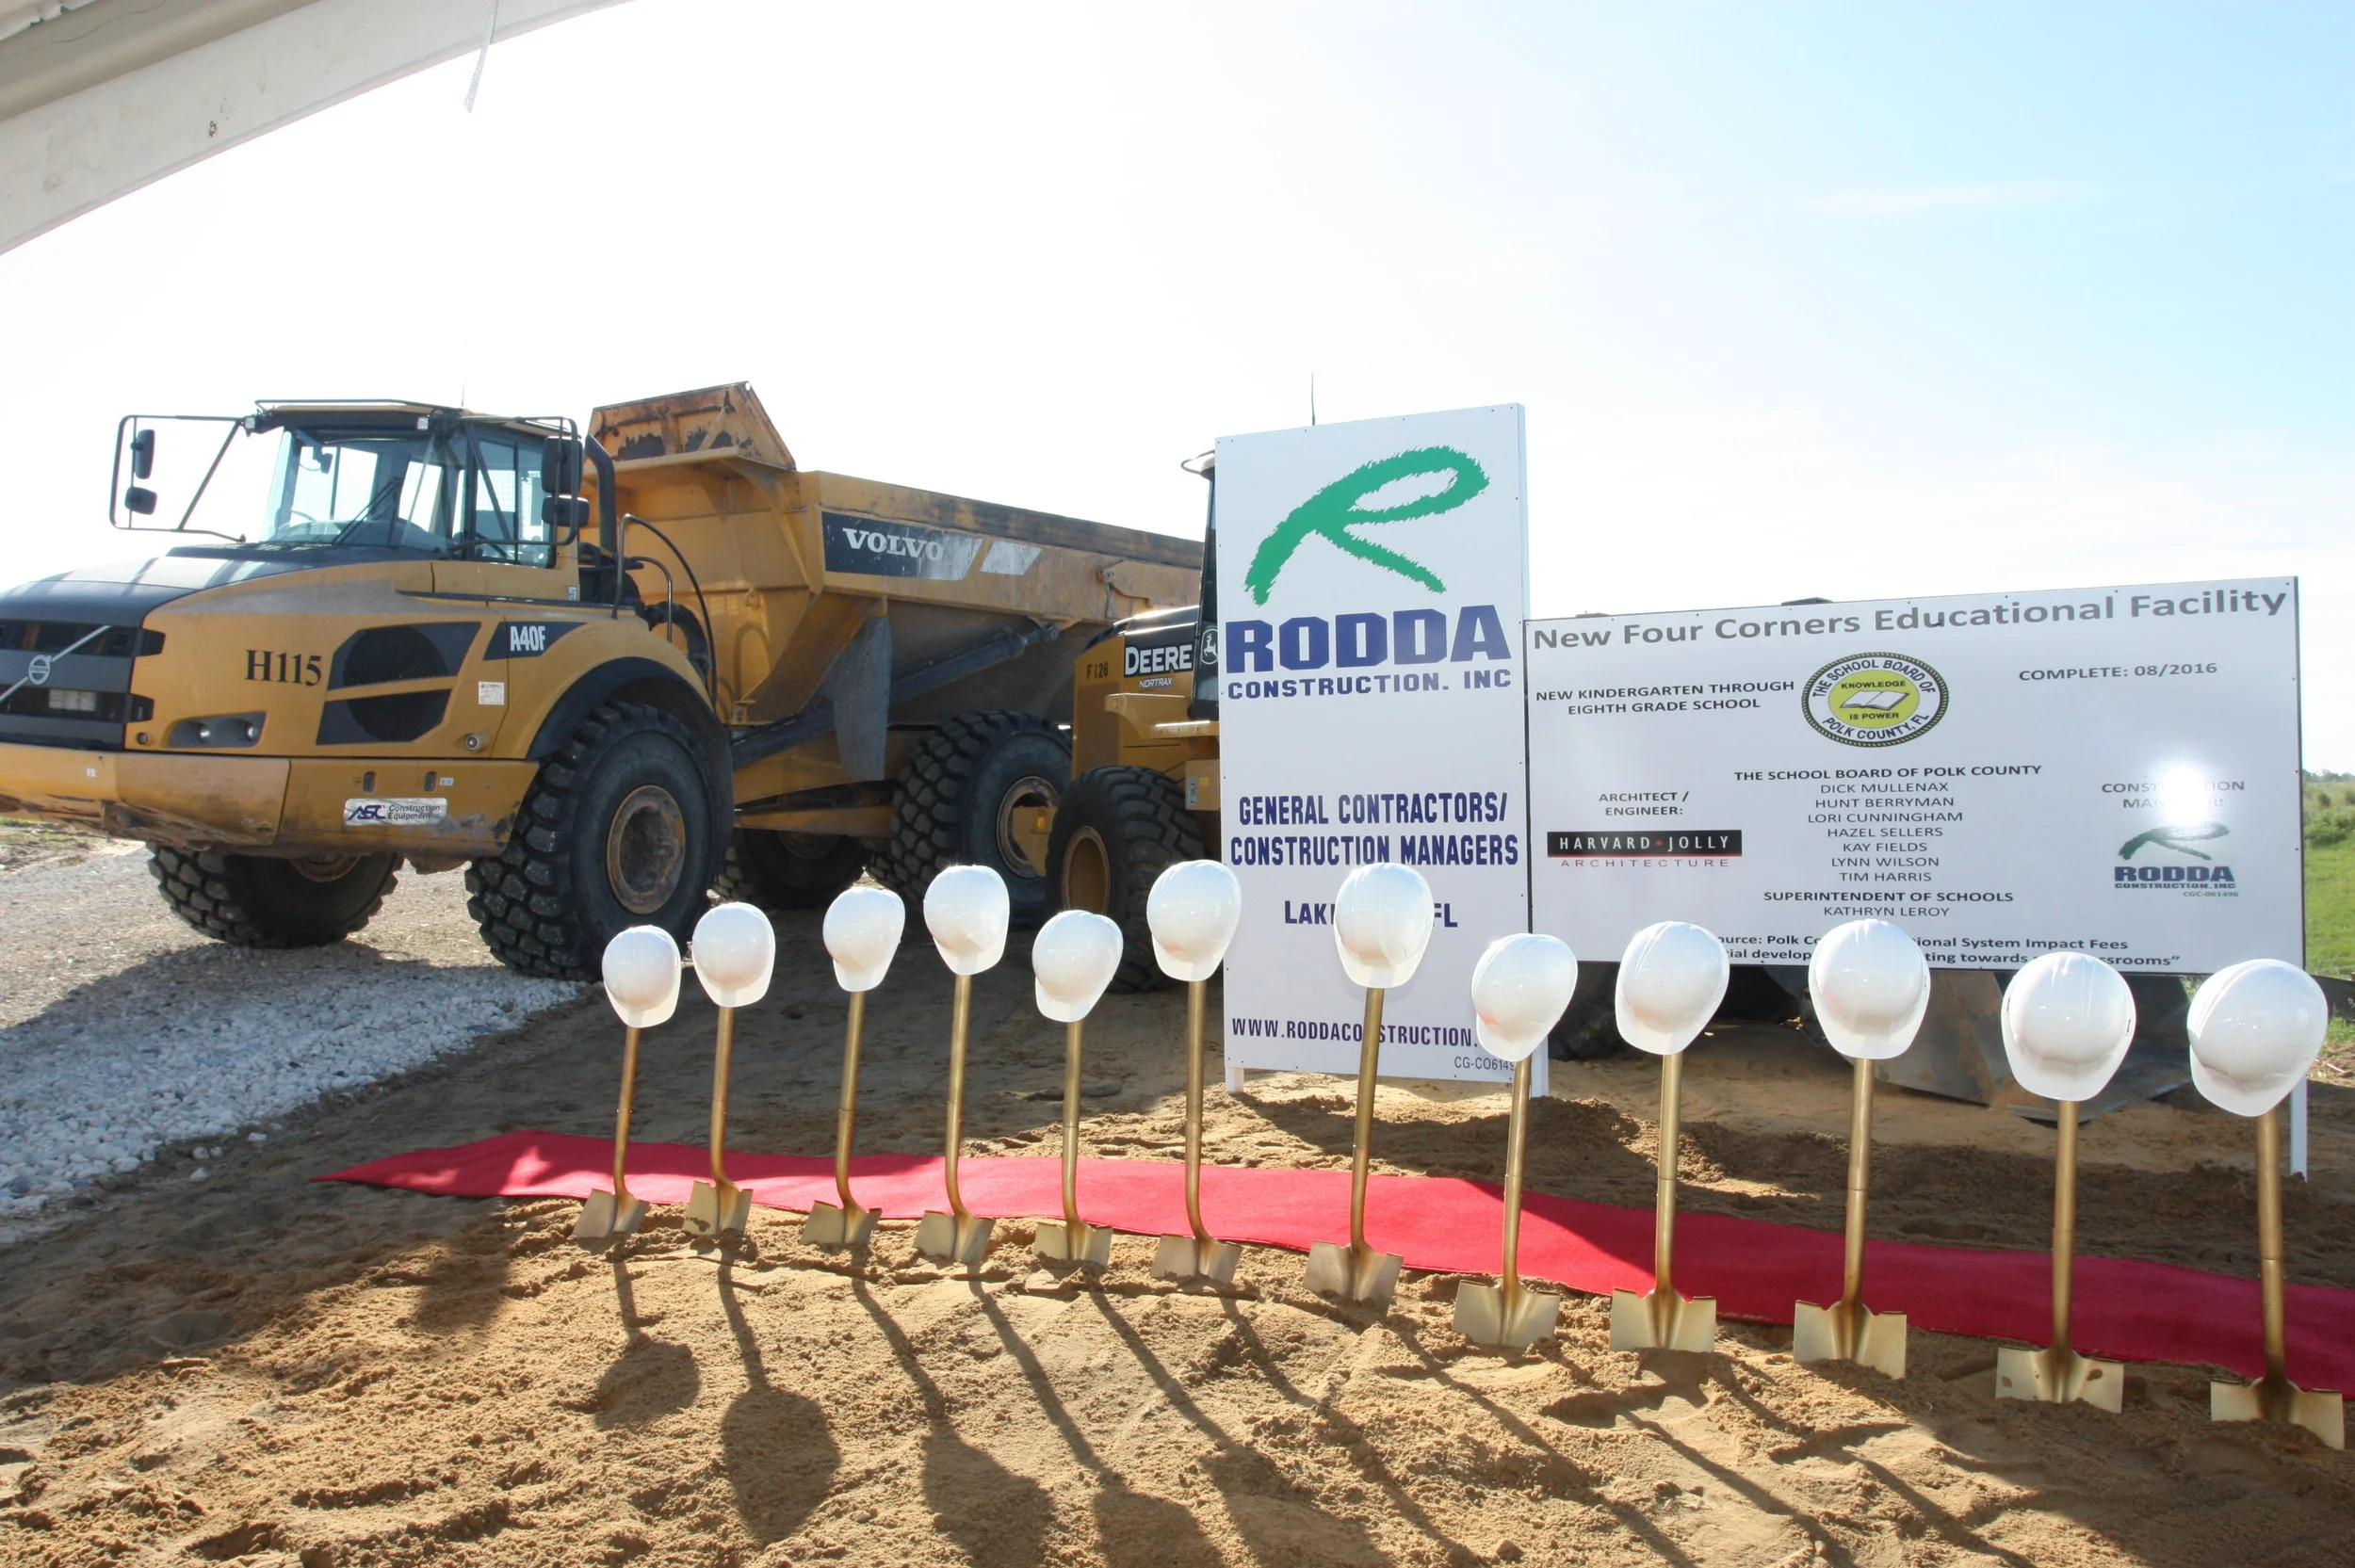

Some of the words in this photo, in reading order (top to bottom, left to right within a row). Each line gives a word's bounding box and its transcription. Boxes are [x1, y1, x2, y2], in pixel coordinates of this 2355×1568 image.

[842, 526, 943, 561] VOLVO
[1535, 629, 1611, 649] New
[1624, 623, 1703, 644] Four
[1715, 613, 1860, 639] Corners
[1876, 595, 2114, 631] Educational
[2131, 590, 2286, 618] Facility
[510, 625, 545, 652] A40F
[1226, 605, 1512, 673] RODDA
[245, 649, 322, 687] H115
[1125, 644, 1193, 676] DEERE
[1464, 669, 1511, 689] INC
[1811, 680, 1833, 698] THE
[1830, 659, 1878, 681] SCHOOL
[1882, 659, 1925, 681] BOARD
[1919, 681, 1937, 693] OF
[2019, 667, 2128, 681] COMPLETE:
[2134, 662, 2217, 678] 08/2016
[1138, 676, 1174, 688] NORTRAX
[1841, 680, 1906, 689] KNOWLEDGE
[1535, 689, 1574, 701] NEW
[1578, 685, 1704, 700] KINDERGARTEN
[1709, 681, 1795, 694] THROUGH
[1567, 703, 1626, 716] EIGHTH
[1632, 700, 1687, 713] GRADE
[1693, 698, 1761, 711] SCHOOL
[1822, 717, 1855, 737] POLK
[1857, 722, 1916, 739] COUNTY,
[1914, 714, 1930, 725] FL
[1734, 770, 1763, 781] THE
[1768, 769, 1831, 781] SCHOOL
[1835, 768, 1892, 780] BOARD
[1897, 768, 1919, 779] OF
[1925, 767, 1966, 777] POLK
[1971, 766, 2042, 776] COUNTY
[1820, 784, 1855, 794] DICK
[1861, 782, 1949, 793] MULLENAX
[1599, 792, 1679, 802] ARCHITECT
[1815, 799, 1860, 809] HUNT
[1864, 797, 1955, 808] BERRYMAN
[347, 804, 386, 821] ASC
[1239, 795, 1328, 825] GENERAL
[1339, 792, 1507, 825] CONTRACTORS/
[1605, 806, 1683, 816] ENGINEER:
[1808, 813, 1842, 824] LORI
[1846, 812, 1963, 823] CUNNINGHAM
[1827, 828, 1876, 838] HAZEL
[1880, 827, 1943, 838] SELLERS
[1230, 835, 1389, 865] CONSTRUCTION
[1401, 833, 1519, 865] MANAGERS
[1560, 836, 1650, 850] HARVARD
[1667, 835, 1729, 851] JOLLY
[1843, 842, 1872, 852] KAY
[1876, 842, 1927, 852] FIELDS
[1561, 858, 1729, 867] ARCHITECTURE
[1831, 857, 1871, 867] LYNN
[1876, 857, 1939, 867] WILSON
[1839, 872, 1869, 881] TIM
[1874, 872, 1931, 882] HARRIS
[2115, 866, 2234, 881] RODDA
[1764, 891, 1905, 902] SUPERINTENDENT
[1909, 892, 1932, 902] OF
[1937, 891, 2014, 902] SCHOOLS
[1285, 900, 1336, 925] LAK
[1824, 906, 1895, 916] KATHRYN
[1900, 907, 1949, 917] LEROY
[1717, 935, 1762, 945] ource:
[1767, 935, 1799, 945] Polk
[1961, 937, 2021, 949] System
[2025, 938, 2085, 951] Impact
[2090, 939, 2128, 949] Fees
[1961, 952, 2026, 963] towards
[1232, 1017, 1478, 1047] WWW.RODDACOSTRUCTION.
